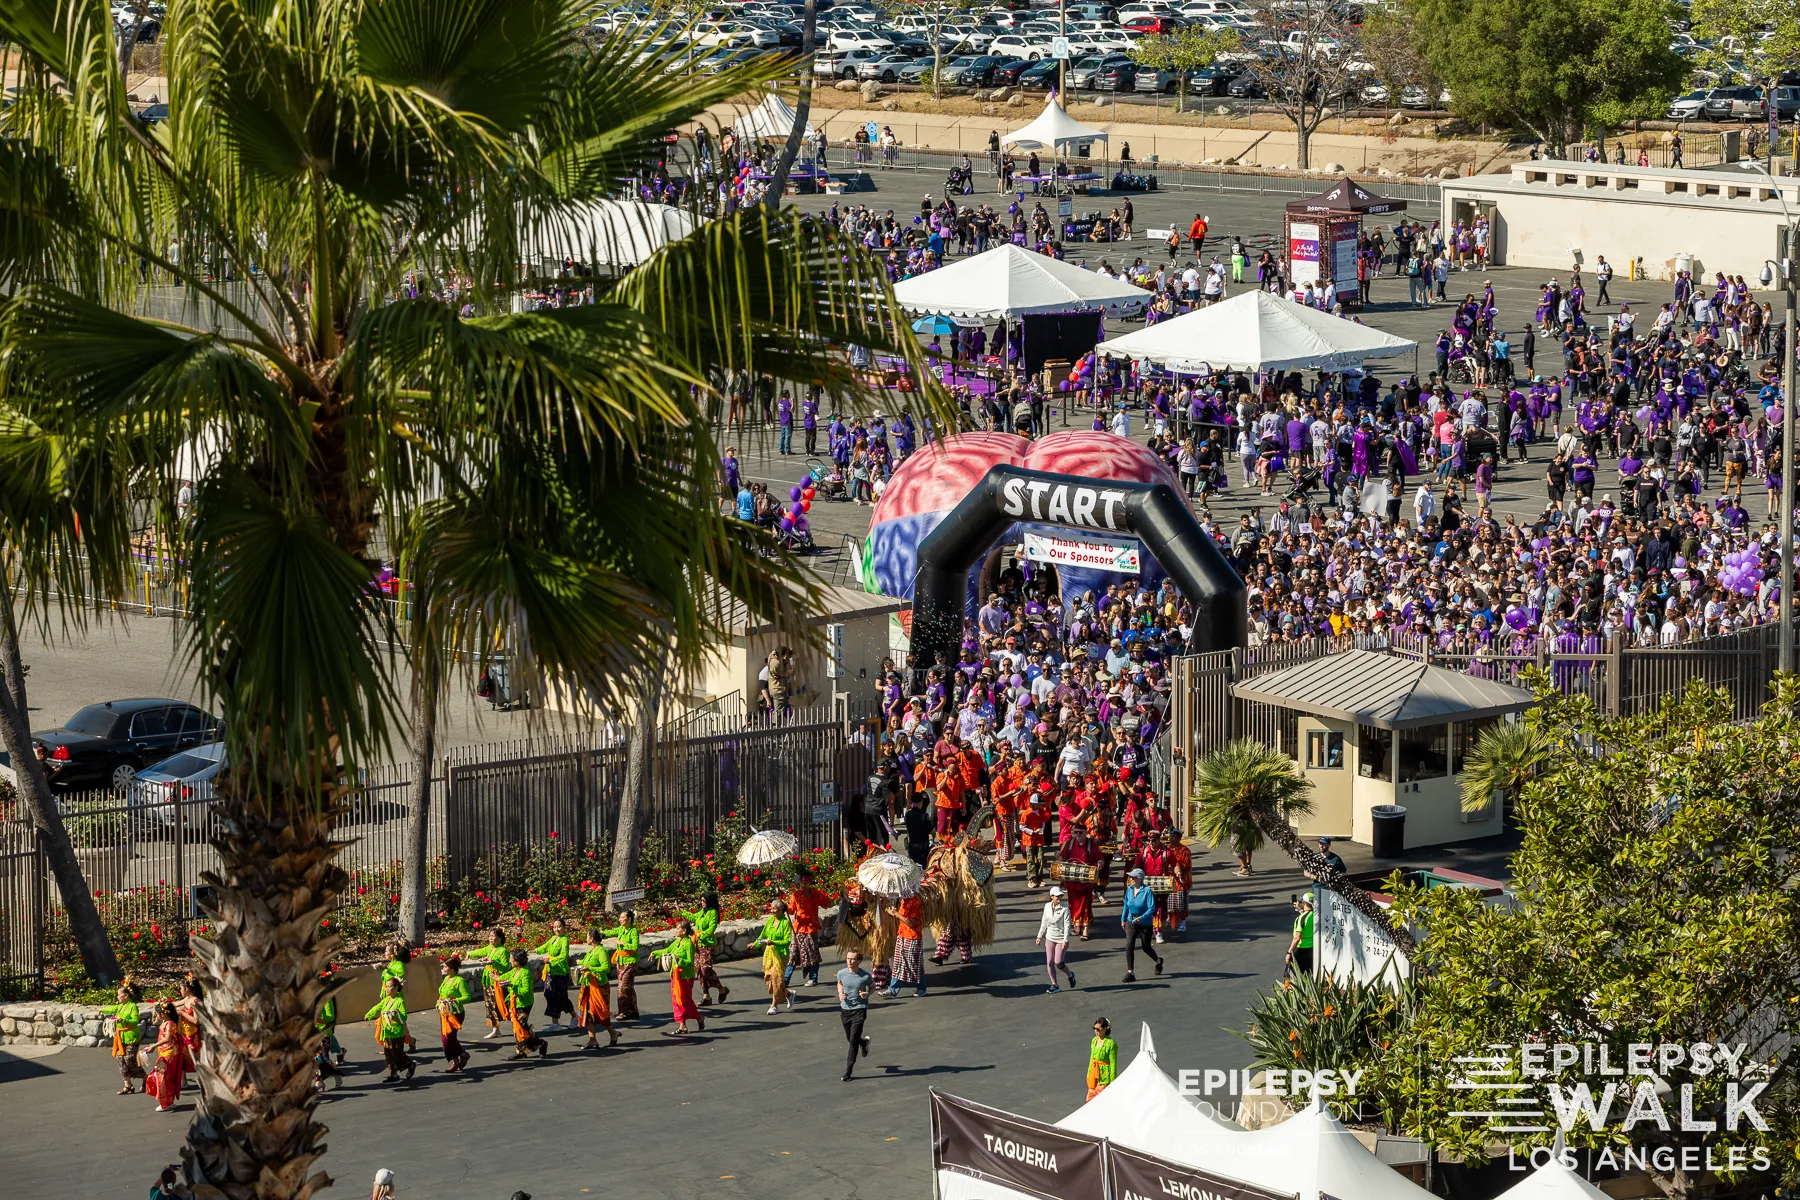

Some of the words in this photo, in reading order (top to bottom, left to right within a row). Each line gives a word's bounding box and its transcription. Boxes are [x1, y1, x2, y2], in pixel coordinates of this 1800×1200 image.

[1003, 477, 1125, 530] START
[1050, 536, 1080, 549] Thank
[1083, 541, 1100, 551] You
[1103, 543, 1114, 552] To
[1050, 549, 1067, 560] Our
[1070, 552, 1114, 565] Sponsors
[1332, 902, 1351, 914] GATES
[984, 1133, 1058, 1174] TAQUERIA
[1158, 1176, 1234, 1200] LEMON
